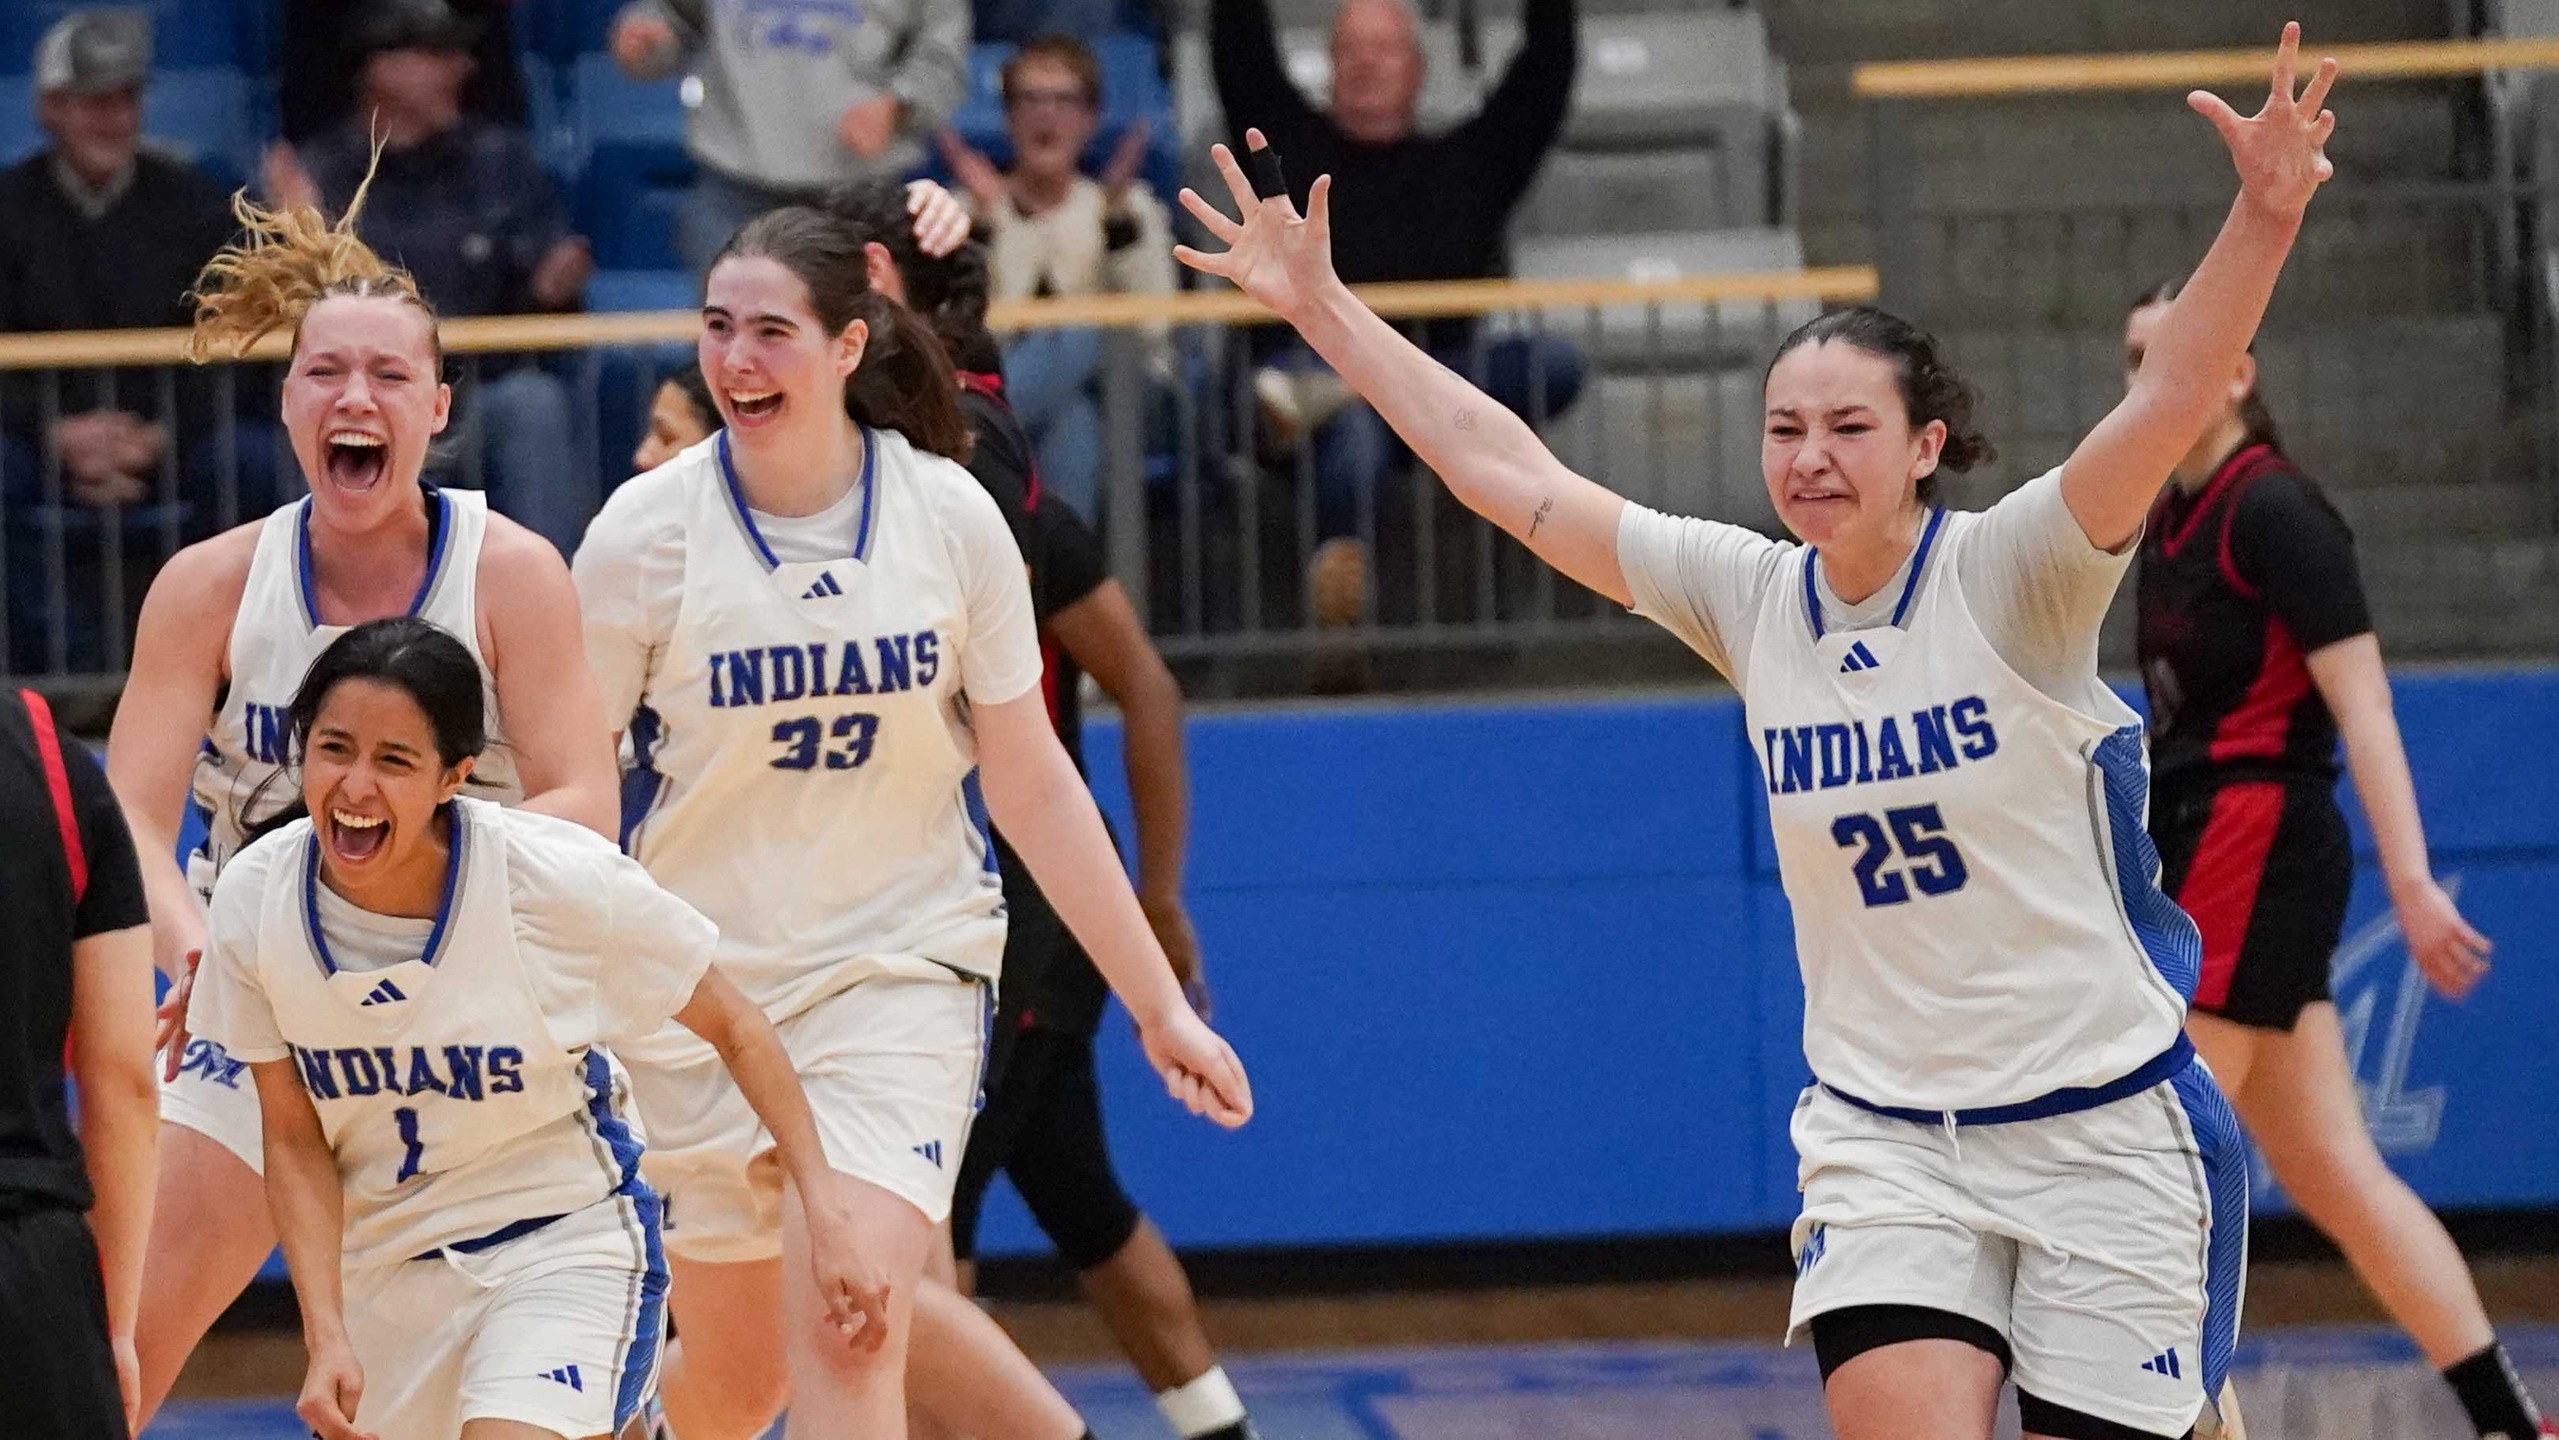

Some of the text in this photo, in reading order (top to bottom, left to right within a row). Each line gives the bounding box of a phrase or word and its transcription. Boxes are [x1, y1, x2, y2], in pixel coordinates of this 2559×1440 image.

[708, 629, 940, 707] INDIANS
[769, 712, 880, 772] 33
[1763, 694, 2000, 795] INDIANS
[1831, 801, 1970, 909] 25
[393, 1106, 424, 1184] 1
